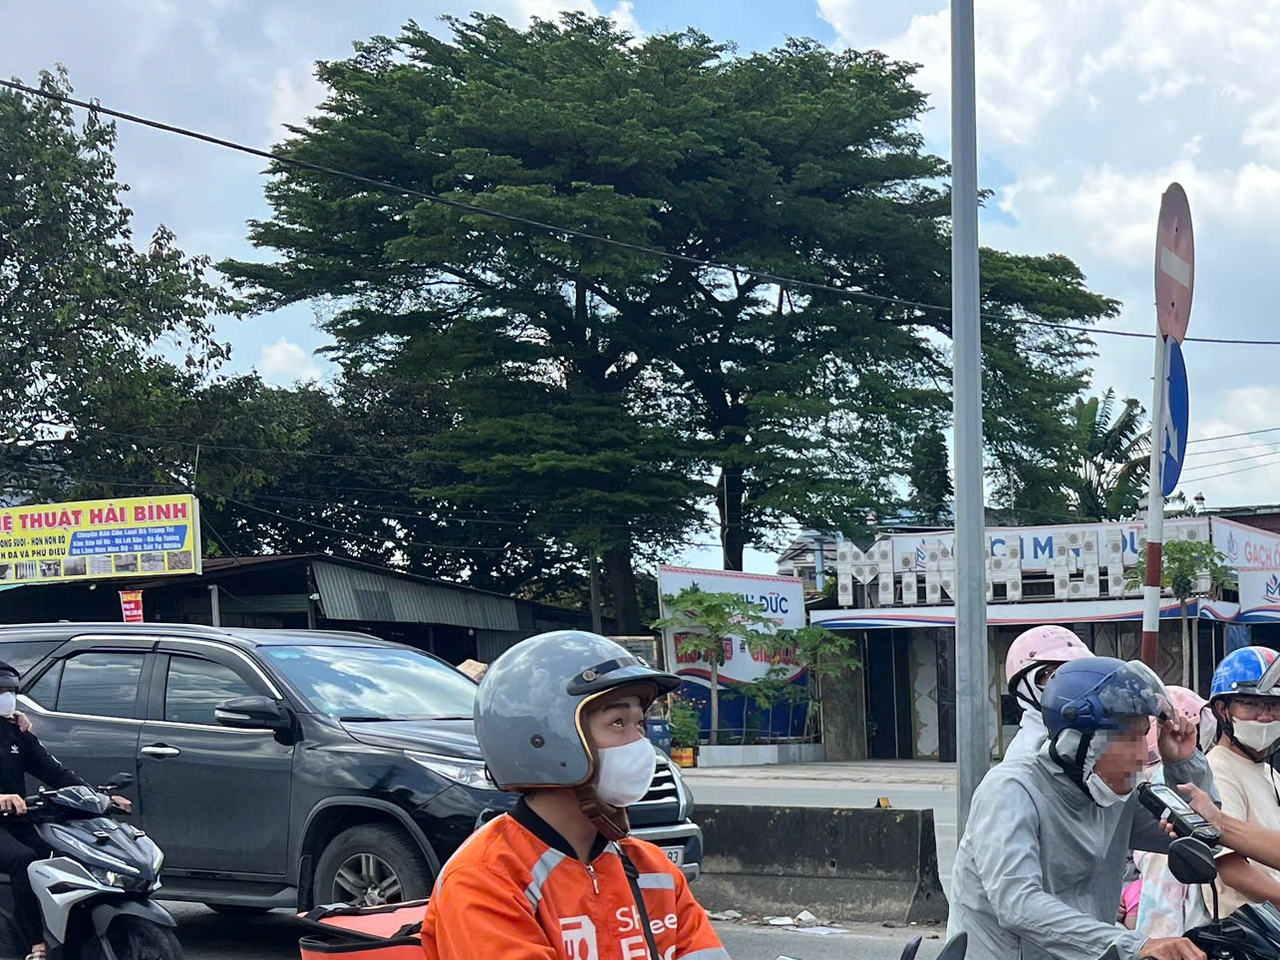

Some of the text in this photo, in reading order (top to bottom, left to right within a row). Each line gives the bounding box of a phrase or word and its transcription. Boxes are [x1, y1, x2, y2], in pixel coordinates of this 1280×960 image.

[19, 508, 82, 532] THUẬT
[89, 503, 127, 525] HẢI
[134, 501, 188, 522] BÌNH
[1244, 541, 1272, 566] GẠCH
